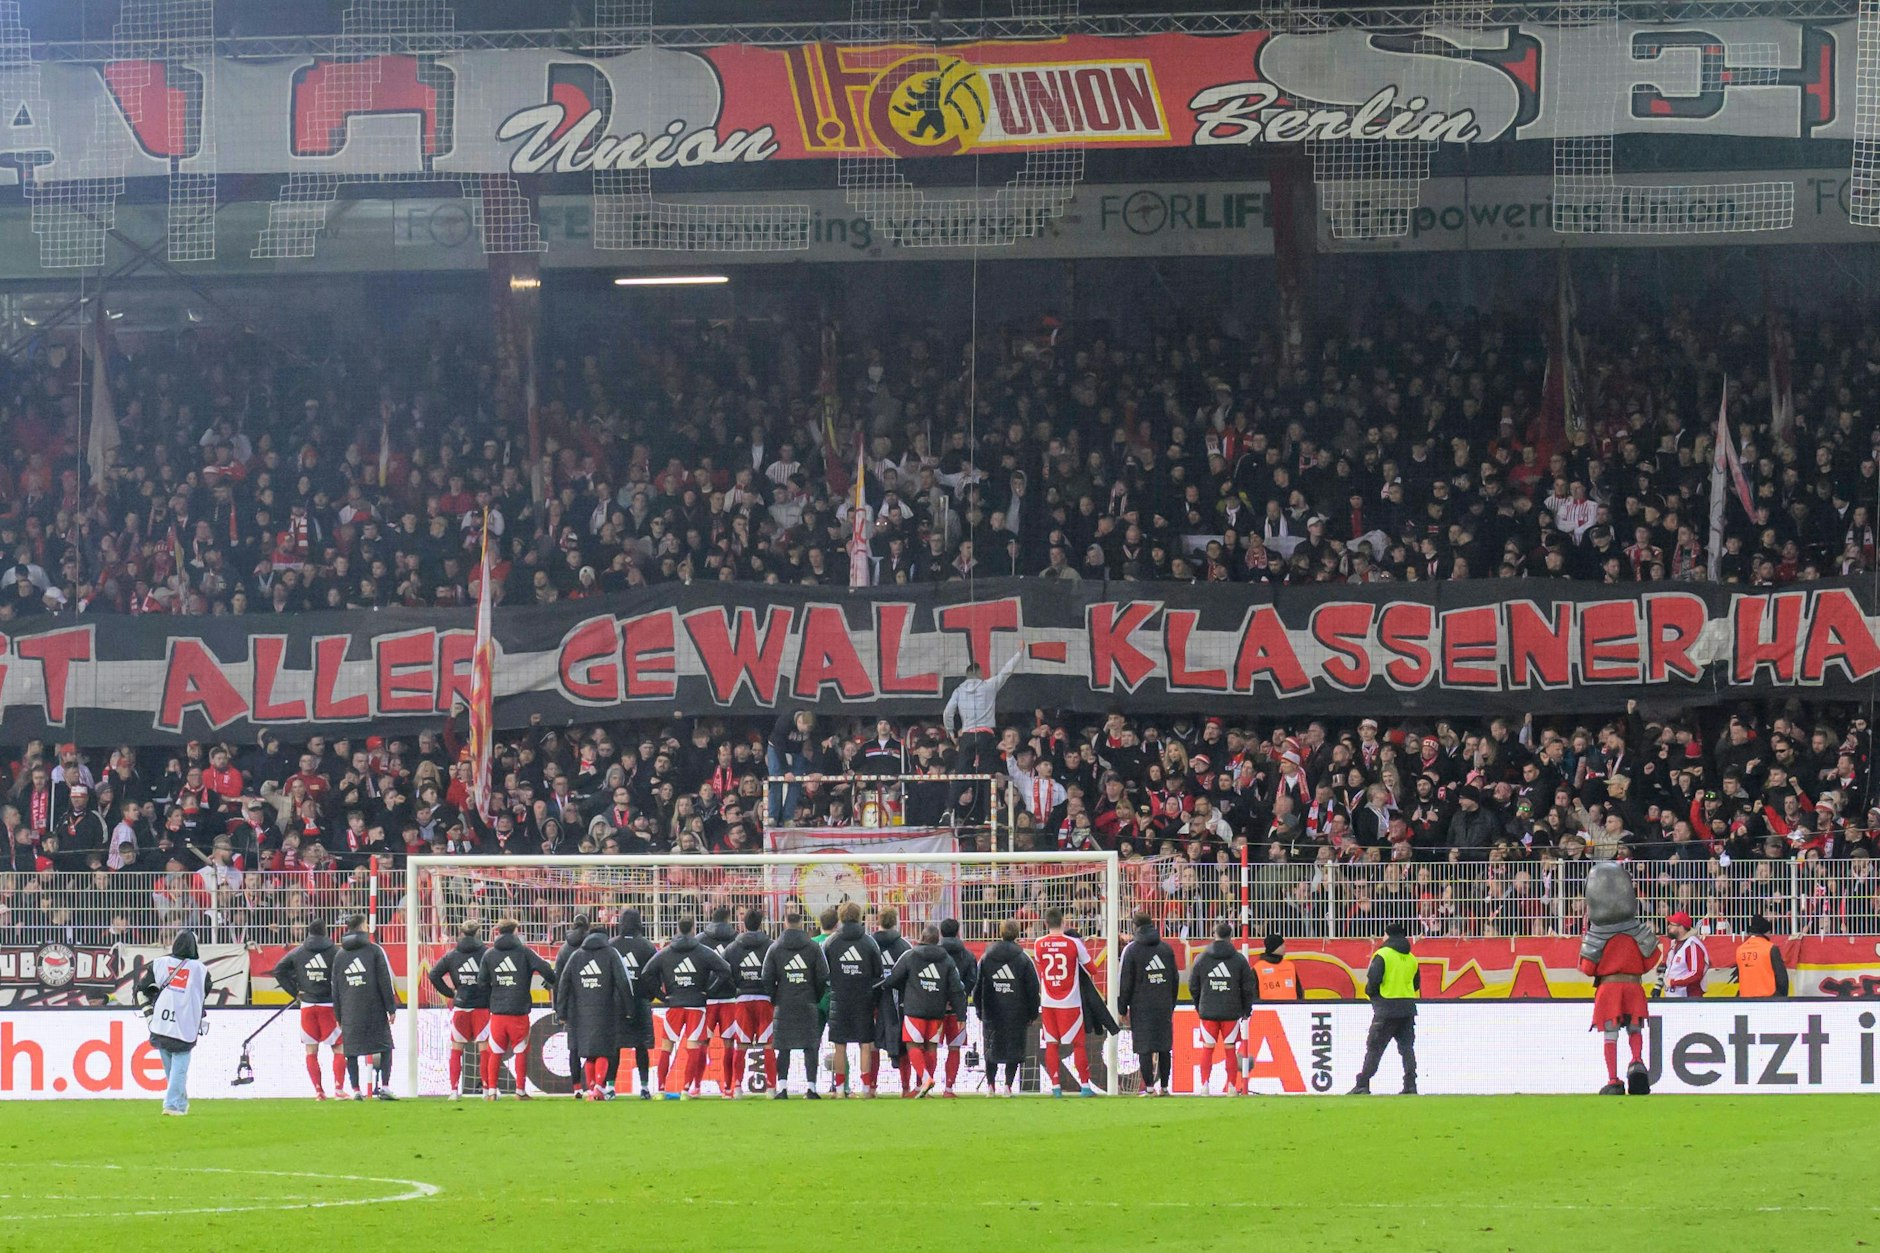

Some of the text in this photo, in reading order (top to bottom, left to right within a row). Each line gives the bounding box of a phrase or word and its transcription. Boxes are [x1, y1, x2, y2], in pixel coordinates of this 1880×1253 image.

[496, 84, 1479, 173] Union Berlin
[988, 66, 1163, 136] UNION
[1101, 190, 1273, 236] FORLIF
[0, 624, 96, 727] T
[1042, 953, 1068, 981] 23
[1263, 981, 1281, 991] 364
[1741, 951, 1758, 961] 379
[161, 1008, 176, 1023] 01
[1649, 1014, 1830, 1087] Jetzt
[1, 1020, 169, 1092] h.de
[1311, 1012, 1333, 1092] GMBH
